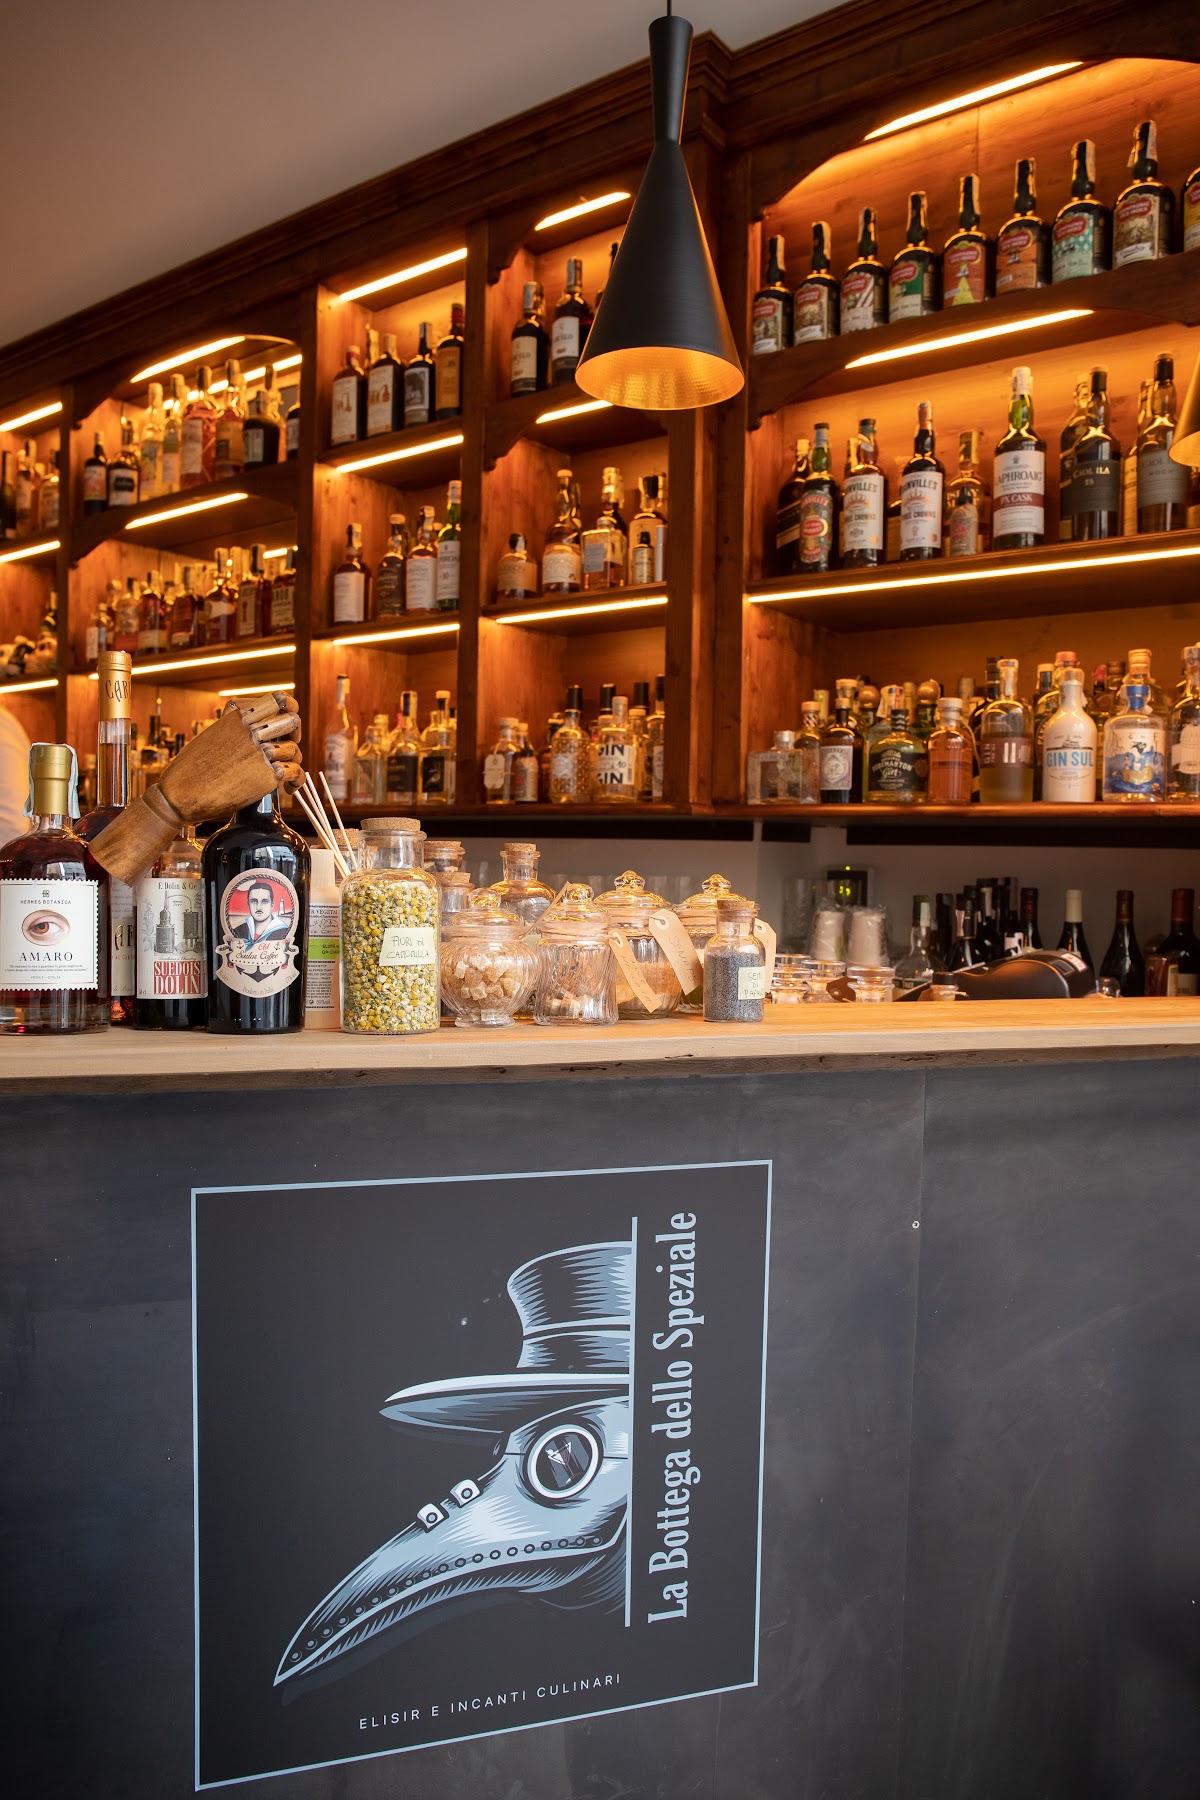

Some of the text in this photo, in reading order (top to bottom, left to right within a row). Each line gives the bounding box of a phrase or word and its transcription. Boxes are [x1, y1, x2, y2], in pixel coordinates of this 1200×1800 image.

[997, 470, 1043, 485] APHROAIG
[1011, 493, 1033, 503] CASK
[1046, 751, 1094, 768] GIN SUL
[165, 881, 180, 890] Dolin
[19, 951, 73, 962] AMARO
[236, 950, 279, 963] Sailor Coffee
[154, 961, 200, 976] SUEDOIS
[155, 975, 200, 995] DOLIN
[648, 1213, 704, 1623] La Bottega dello Speziale
[359, 1673, 621, 1730] ELISIR E INCANTI CULINARI
